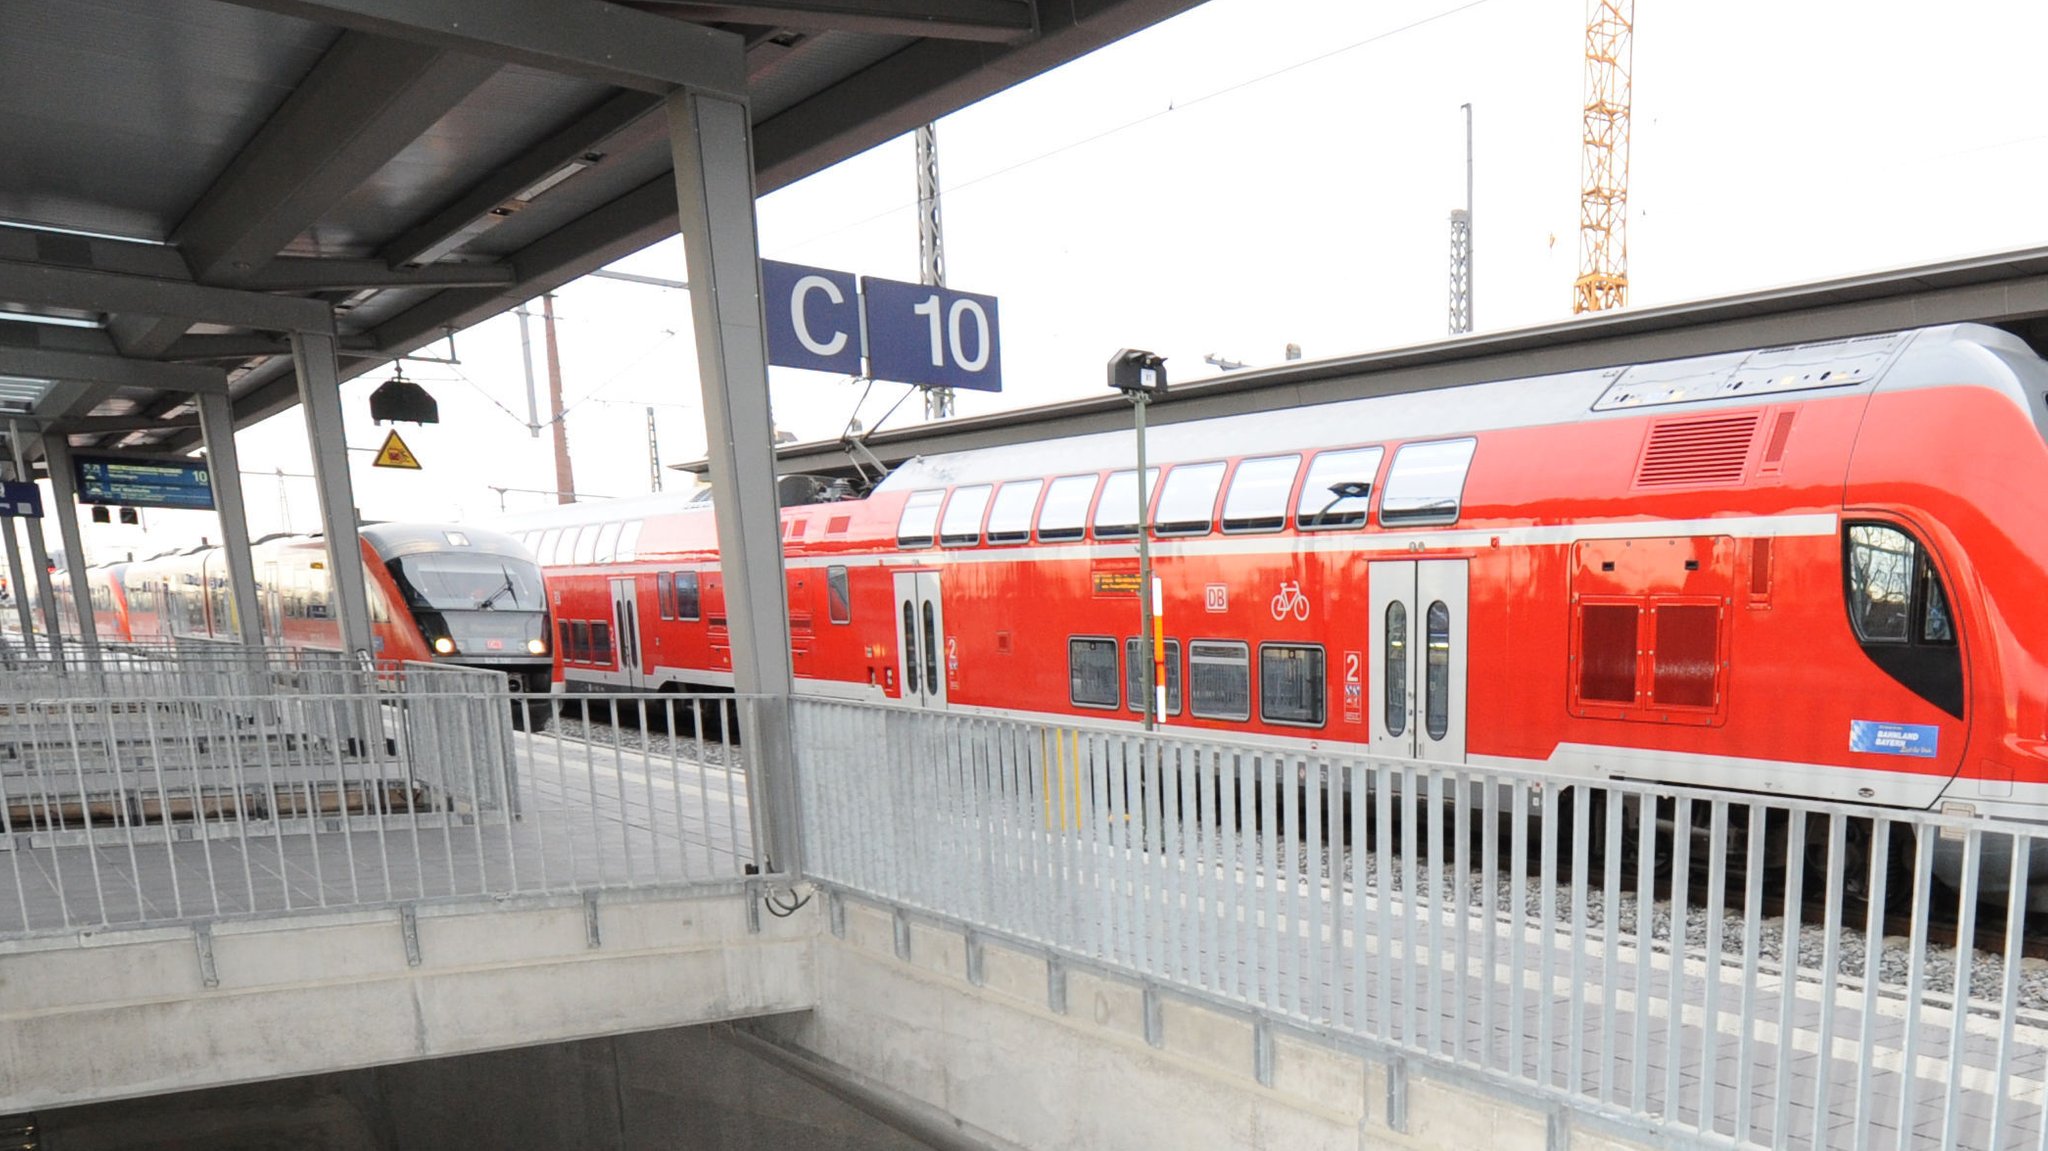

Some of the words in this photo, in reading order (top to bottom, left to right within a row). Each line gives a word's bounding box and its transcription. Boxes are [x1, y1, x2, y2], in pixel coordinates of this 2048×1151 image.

[791, 275, 848, 356] C
[914, 295, 990, 373] 10
[192, 470, 208, 483] 10
[1207, 587, 1226, 608] DB
[948, 638, 957, 659] 2
[1347, 654, 1359, 682] 2
[1875, 738, 1906, 747] BAYERN
[1877, 730, 1919, 740] BAHNLAND
